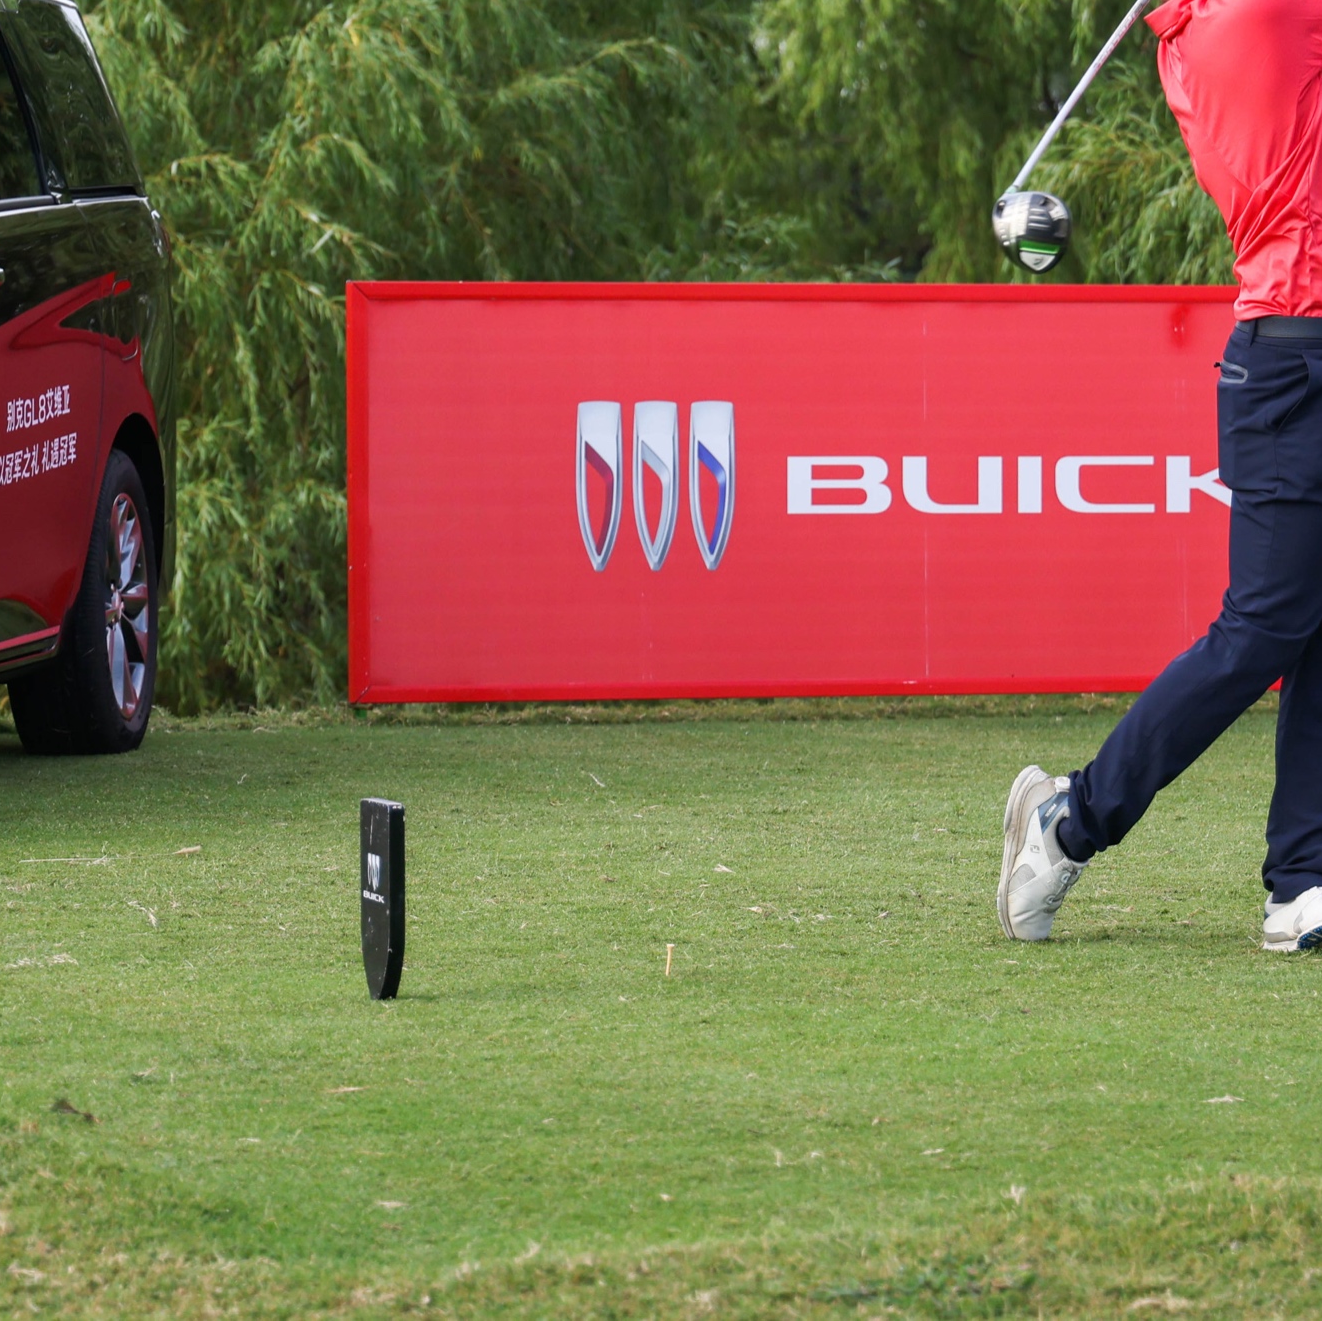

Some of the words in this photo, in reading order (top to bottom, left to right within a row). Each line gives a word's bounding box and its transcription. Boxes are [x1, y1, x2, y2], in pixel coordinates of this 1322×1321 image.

[6, 384, 70, 433] 别克GL8艾维亚
[42, 432, 77, 473] 礼遇冠军
[363, 889, 385, 903] BUICK
